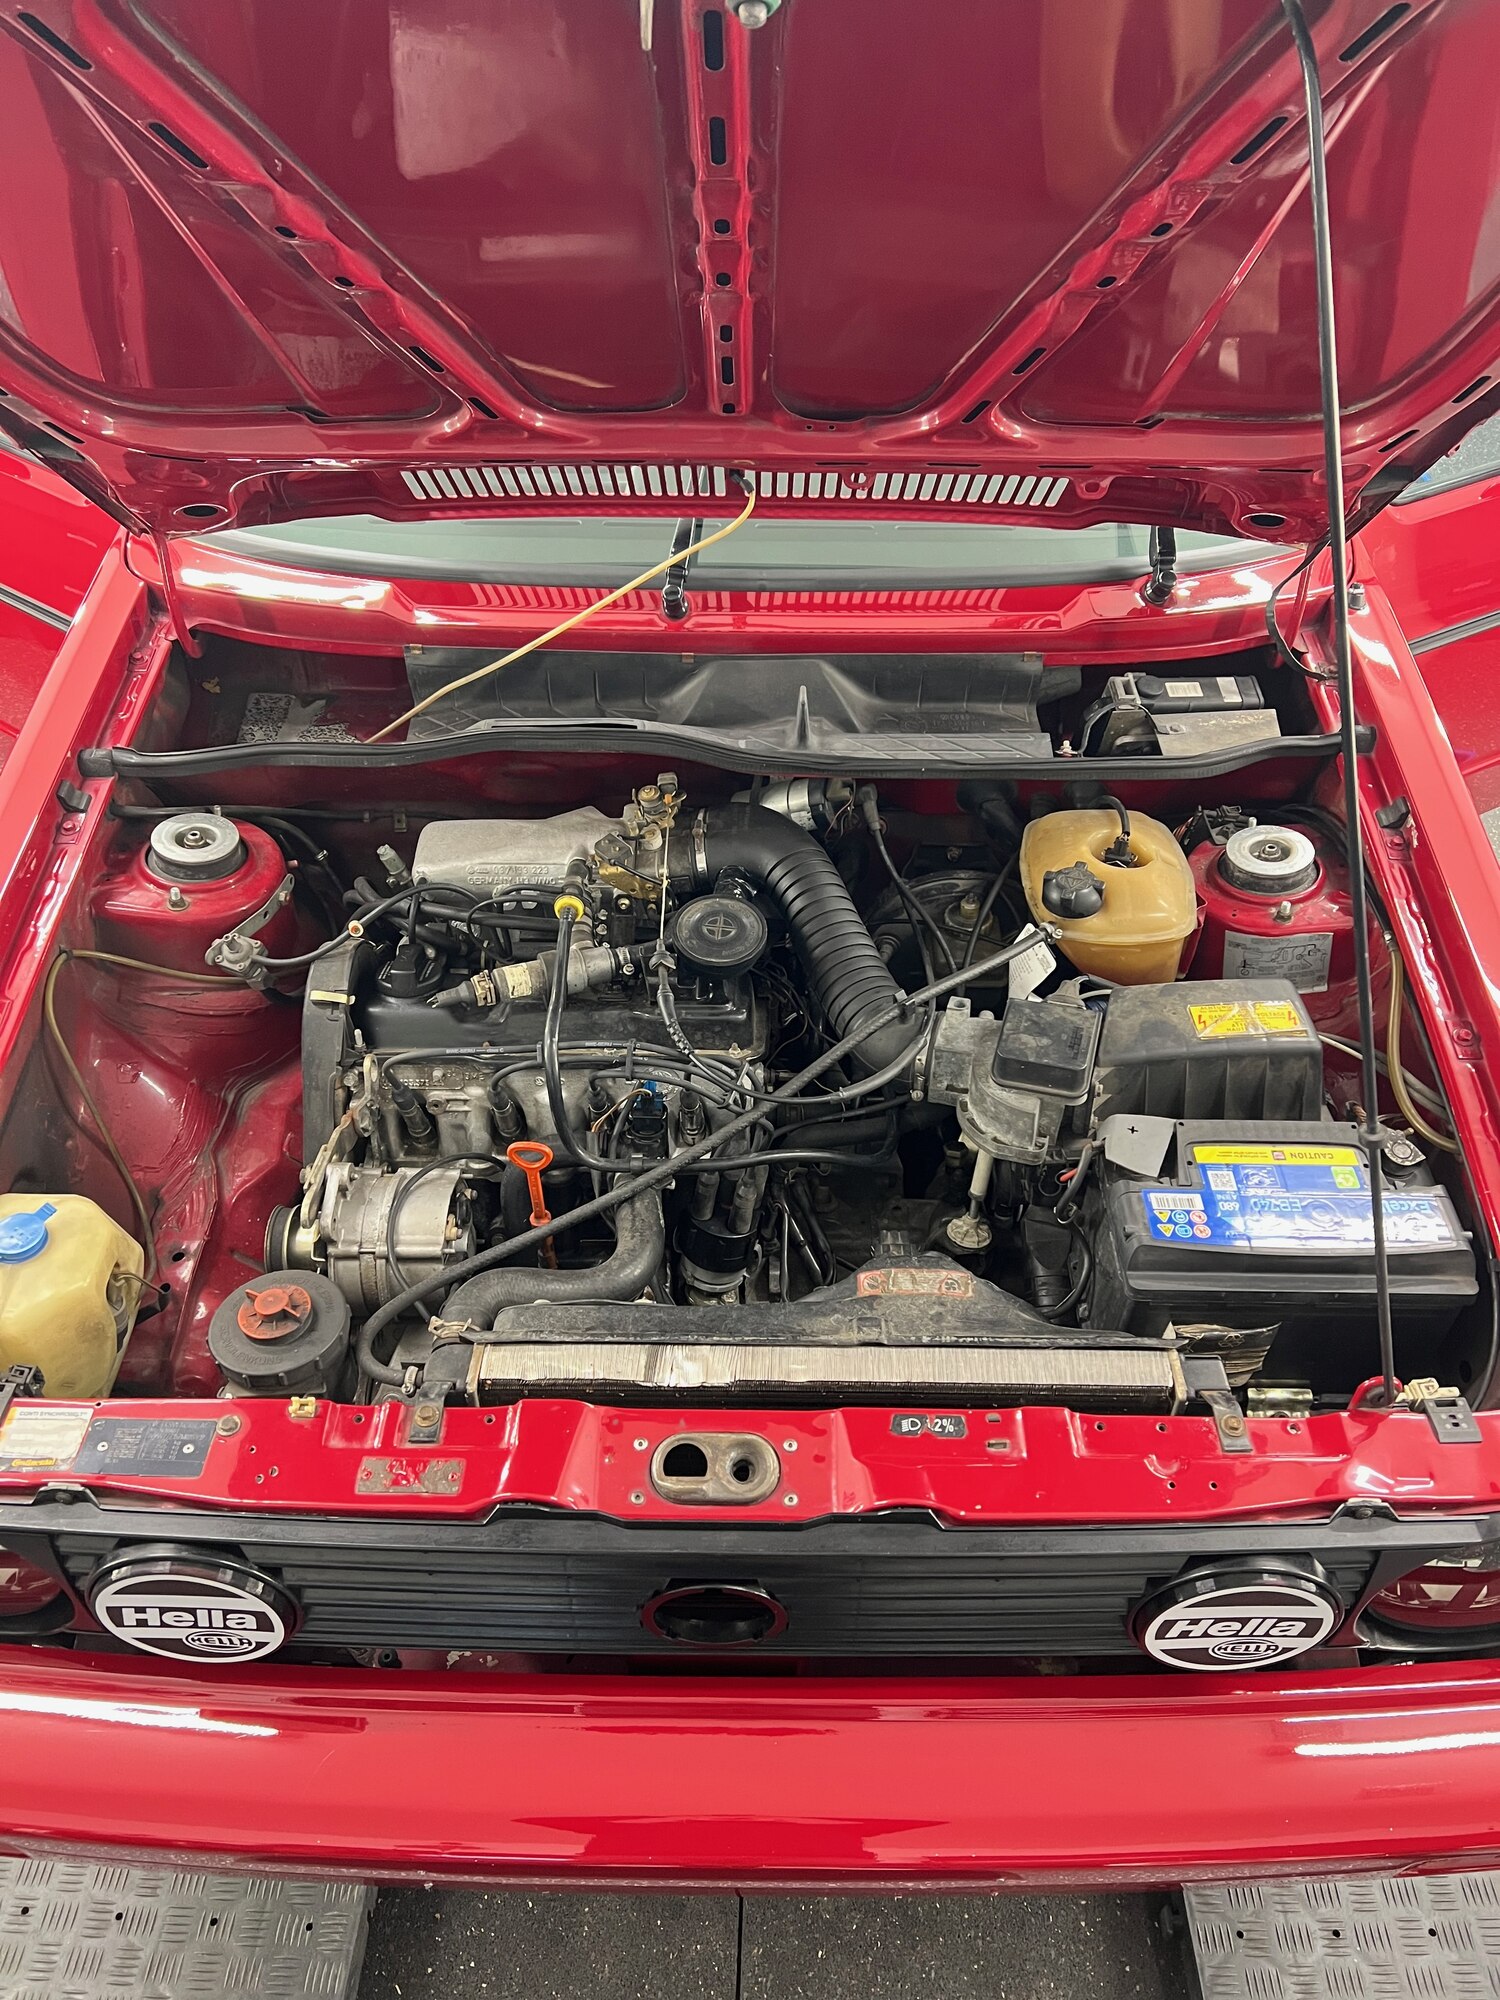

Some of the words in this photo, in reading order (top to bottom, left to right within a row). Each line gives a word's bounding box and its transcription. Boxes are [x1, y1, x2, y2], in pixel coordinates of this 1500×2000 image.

[1289, 1152, 1334, 1160] CAUTION
[1219, 1201, 1240, 1211] 680
[1250, 1198, 1302, 1212] EB740
[121, 1607, 257, 1630] Hella
[1165, 1618, 1307, 1638] Hella
[191, 1636, 250, 1649] HELLA
[1217, 1643, 1279, 1654] HELLA
